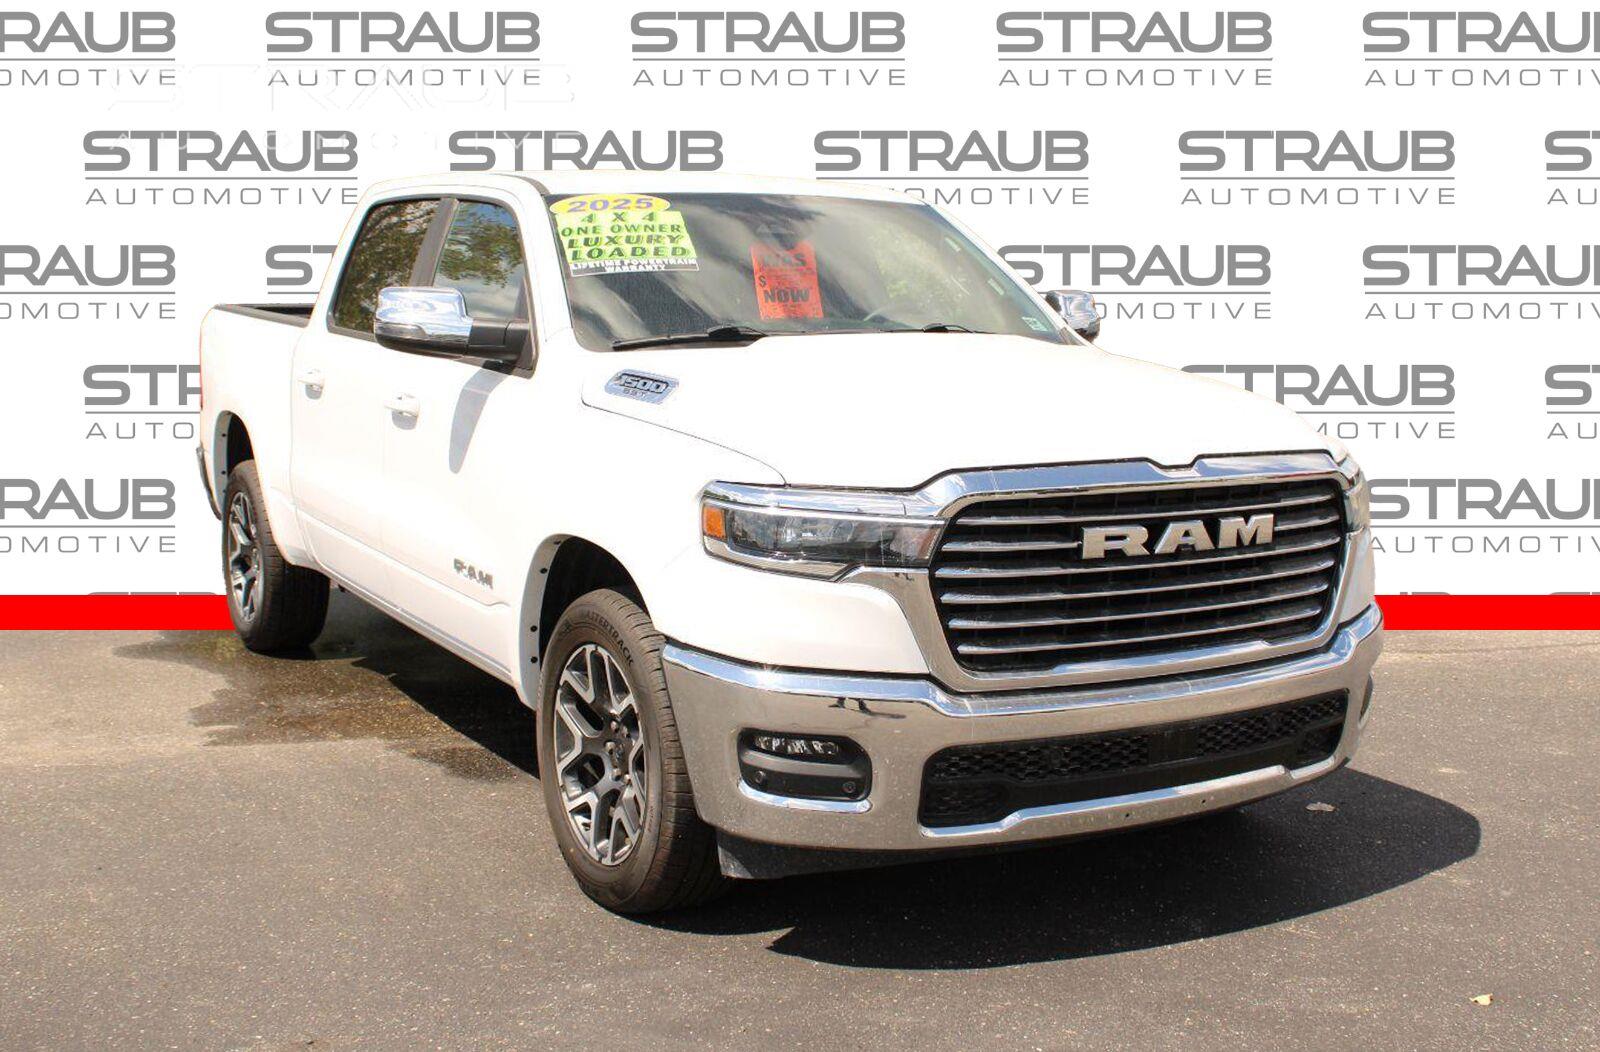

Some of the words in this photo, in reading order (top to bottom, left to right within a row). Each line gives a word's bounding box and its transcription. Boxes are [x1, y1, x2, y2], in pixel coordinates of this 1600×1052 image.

[567, 198, 653, 212] 2025
[581, 213, 596, 223] 4
[642, 212, 656, 222] 4
[561, 226, 601, 237] ONE
[610, 224, 681, 234] OWNER
[568, 235, 684, 249] LUXURY
[571, 247, 687, 261] LOADED
[763, 288, 810, 303] NOW
[1081, 513, 1275, 560] RAM
[453, 558, 493, 590] RAM
